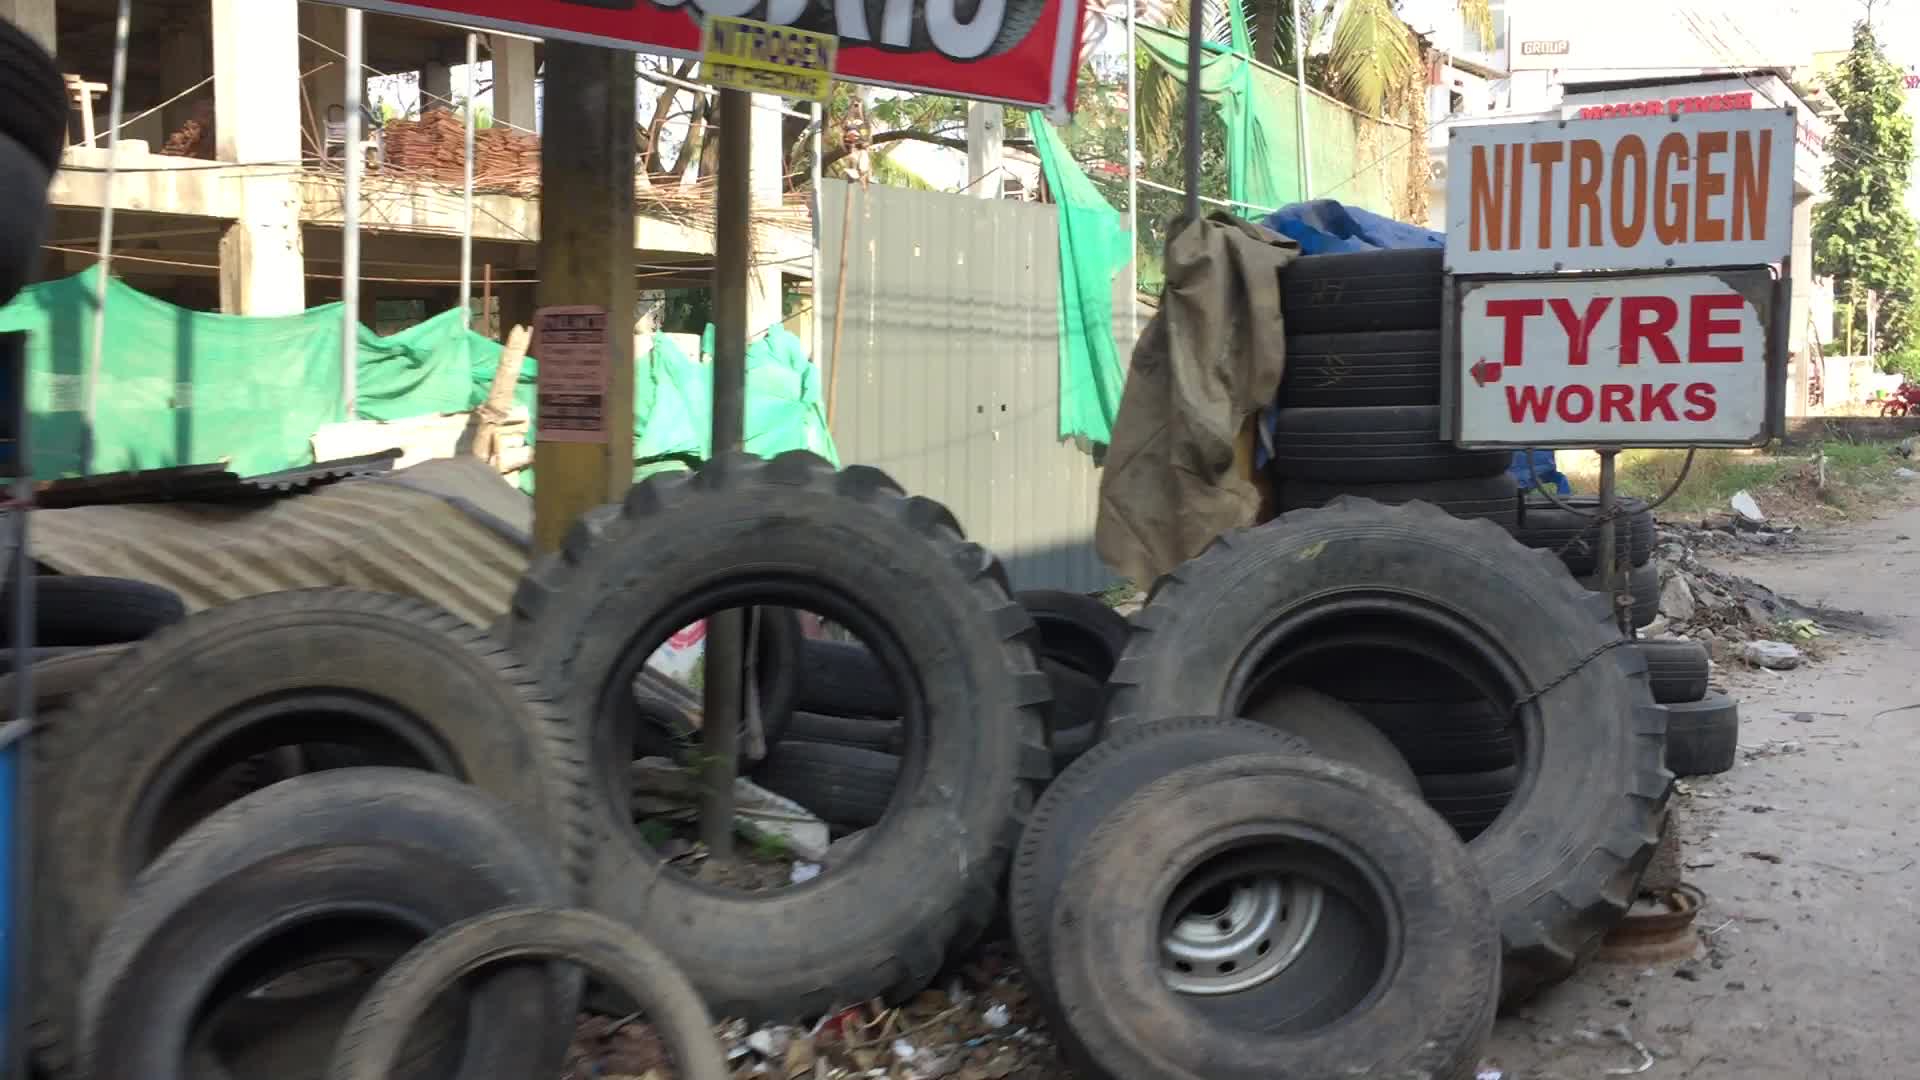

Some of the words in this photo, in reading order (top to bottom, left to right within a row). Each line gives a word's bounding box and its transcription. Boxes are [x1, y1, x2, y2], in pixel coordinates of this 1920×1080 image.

[712, 21, 830, 70] NITROGEN
[1522, 41, 1568, 55] GROUP
[1579, 100, 1664, 121] MOTOR
[1469, 129, 1772, 252] NITROGEN
[1486, 294, 1745, 367] TYRE
[1505, 382, 1717, 423] WORKS
